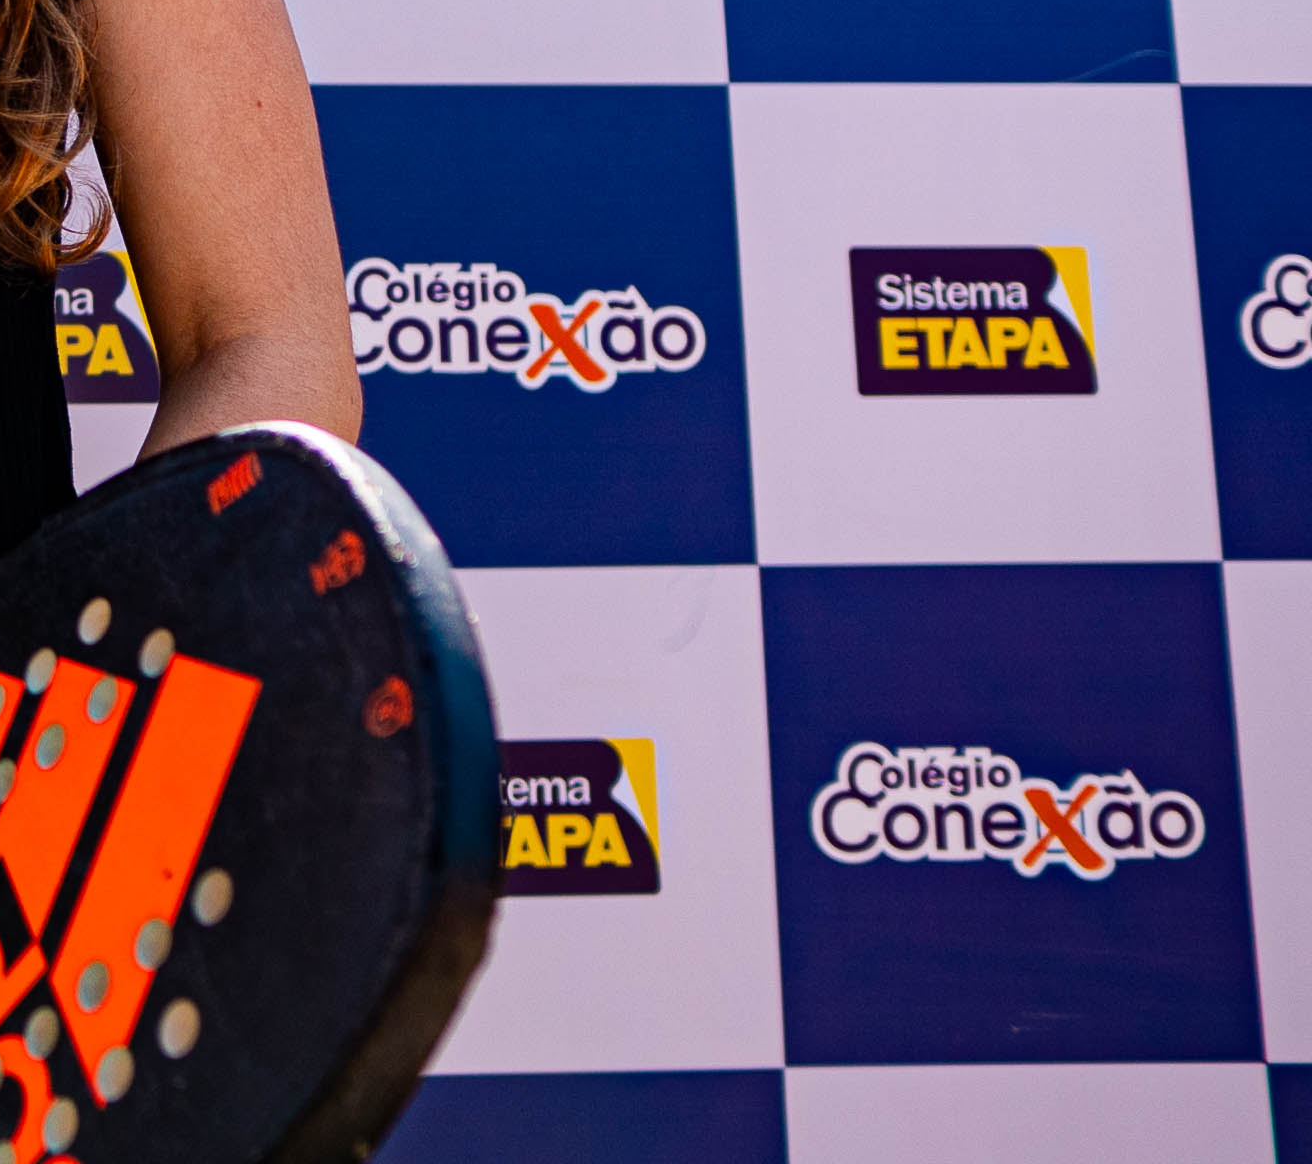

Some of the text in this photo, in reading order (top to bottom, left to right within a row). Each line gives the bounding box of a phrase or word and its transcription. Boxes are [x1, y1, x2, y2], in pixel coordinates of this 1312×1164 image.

[354, 267, 518, 312] Colégio
[877, 274, 1028, 310] Sistema
[879, 316, 1070, 369] ETAPA
[847, 750, 1012, 799] Colégio
